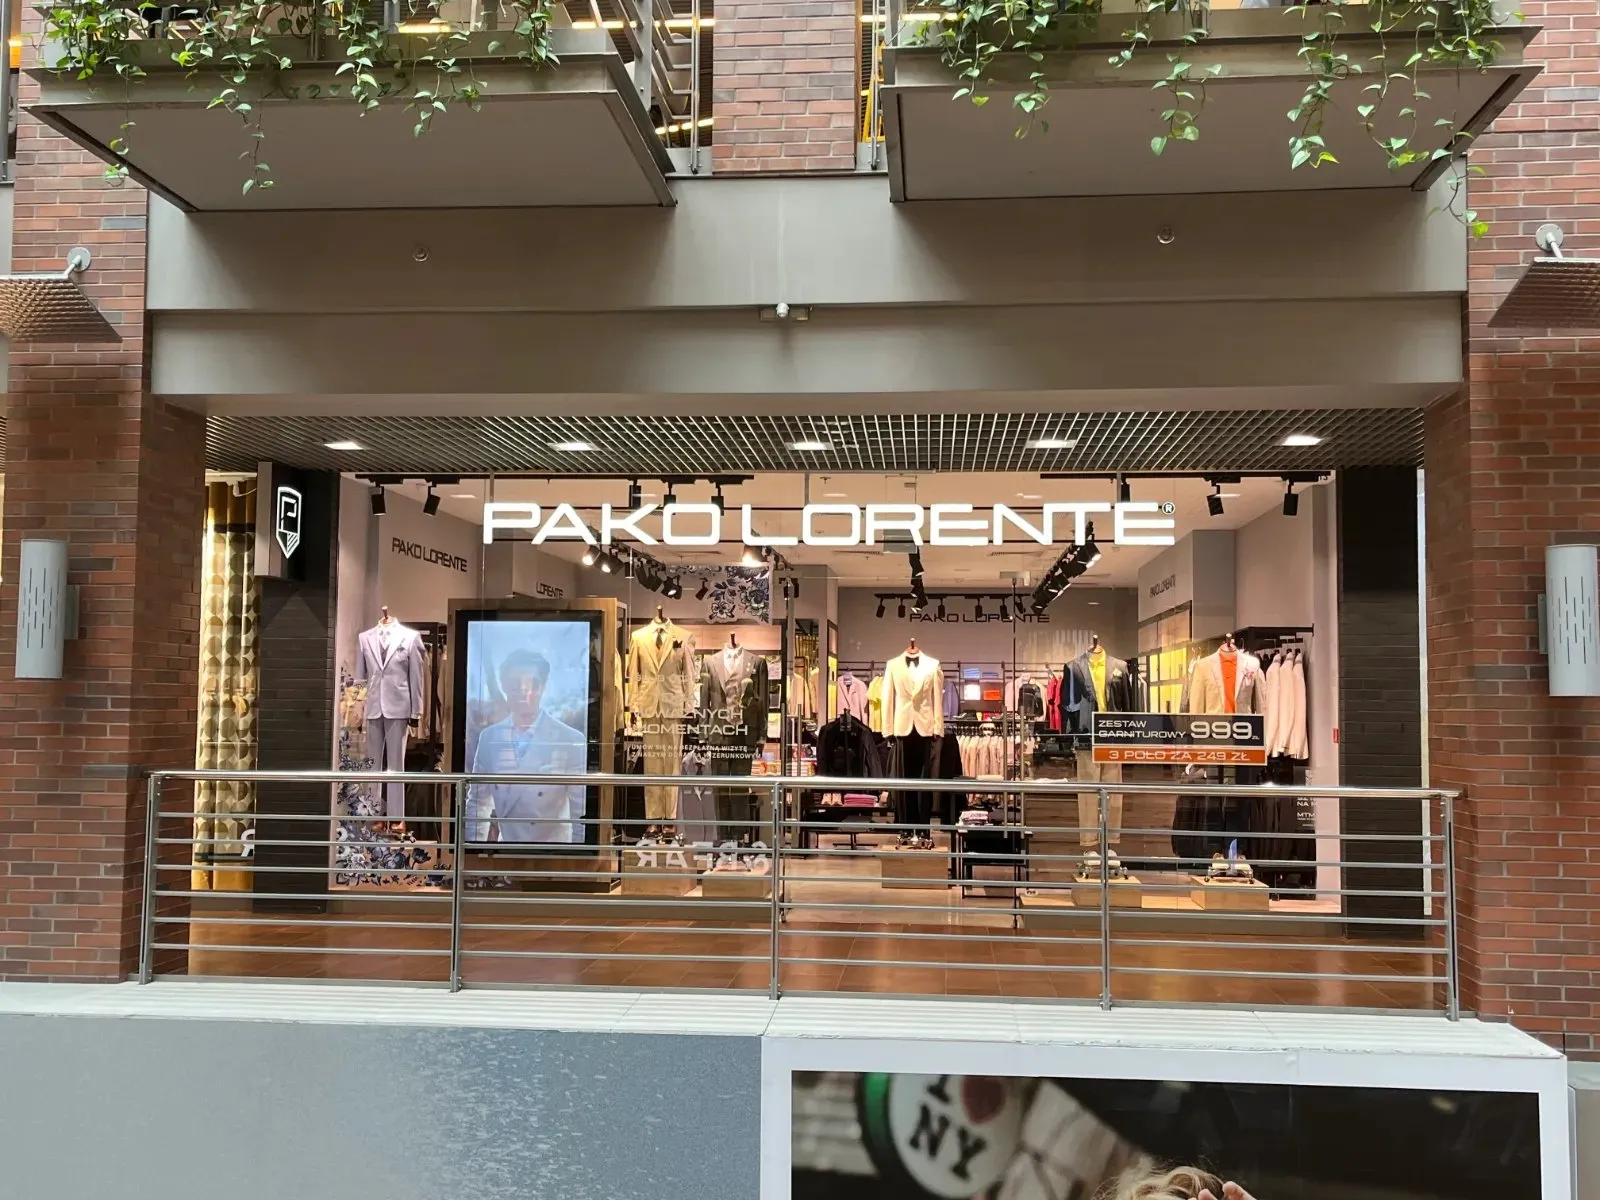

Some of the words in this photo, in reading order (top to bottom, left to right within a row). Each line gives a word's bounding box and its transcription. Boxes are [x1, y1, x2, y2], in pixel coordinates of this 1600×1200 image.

[483, 502, 720, 546] PAKO
[392, 537, 422, 560] PAKO
[423, 546, 468, 573] LORENTE
[536, 580, 564, 600] LORENTE
[632, 723, 748, 736] MOMENTACH
[1098, 720, 1147, 729] ZESTAW
[1190, 721, 1253, 740] 999
[1098, 730, 1187, 739] GARNITUROWY
[1109, 752, 1119, 760] 3
[1170, 751, 1192, 760] ZA
[1197, 752, 1226, 761] 249
[1231, 752, 1250, 761] ZŁ
[909, 1103, 987, 1181] NY
